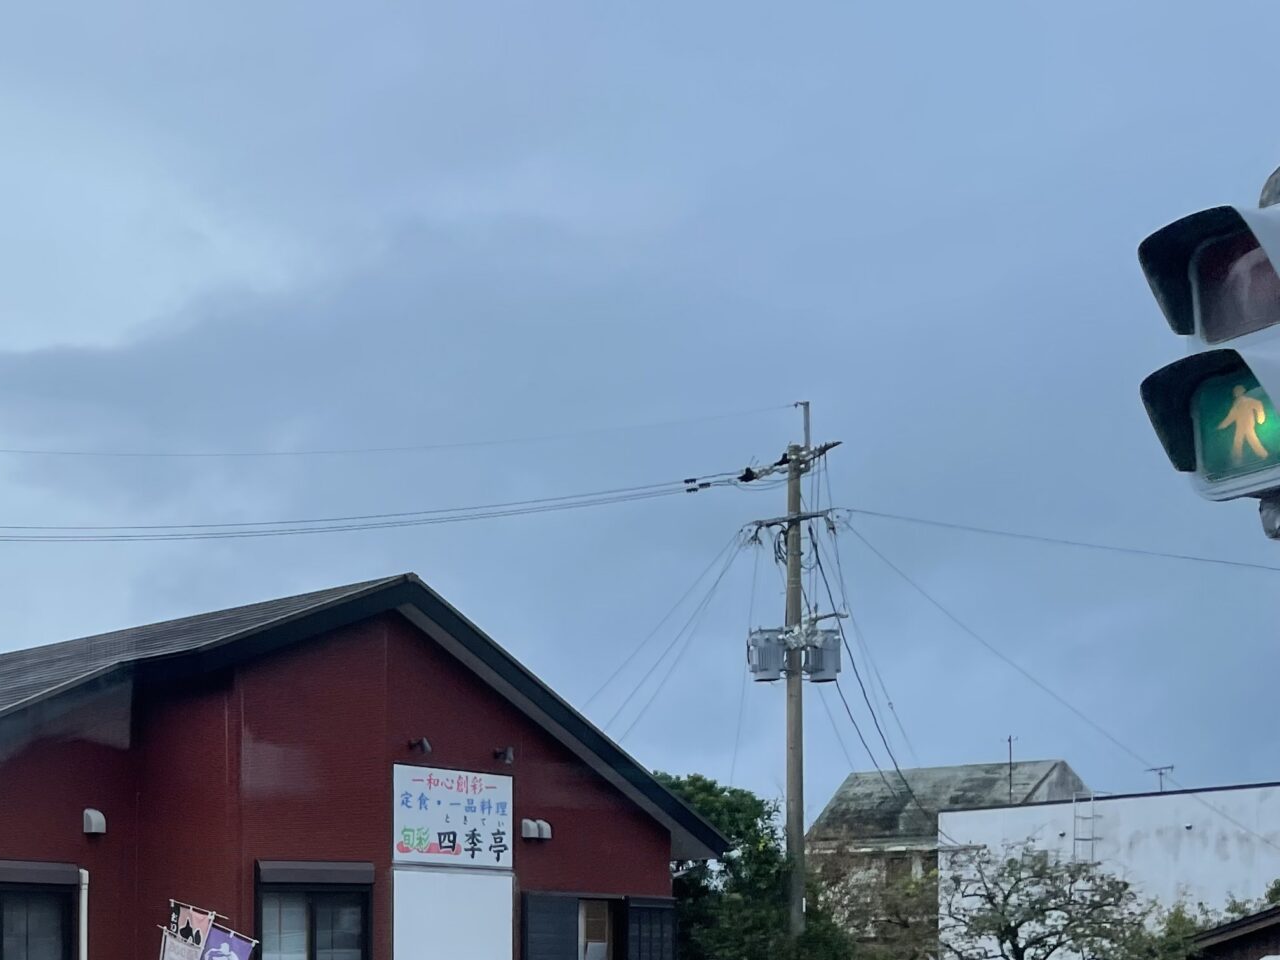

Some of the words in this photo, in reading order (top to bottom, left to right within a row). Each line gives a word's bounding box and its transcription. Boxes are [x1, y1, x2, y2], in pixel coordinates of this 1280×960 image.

[401, 826, 430, 850] 旬彩
[437, 828, 509, 862] 四季亭
